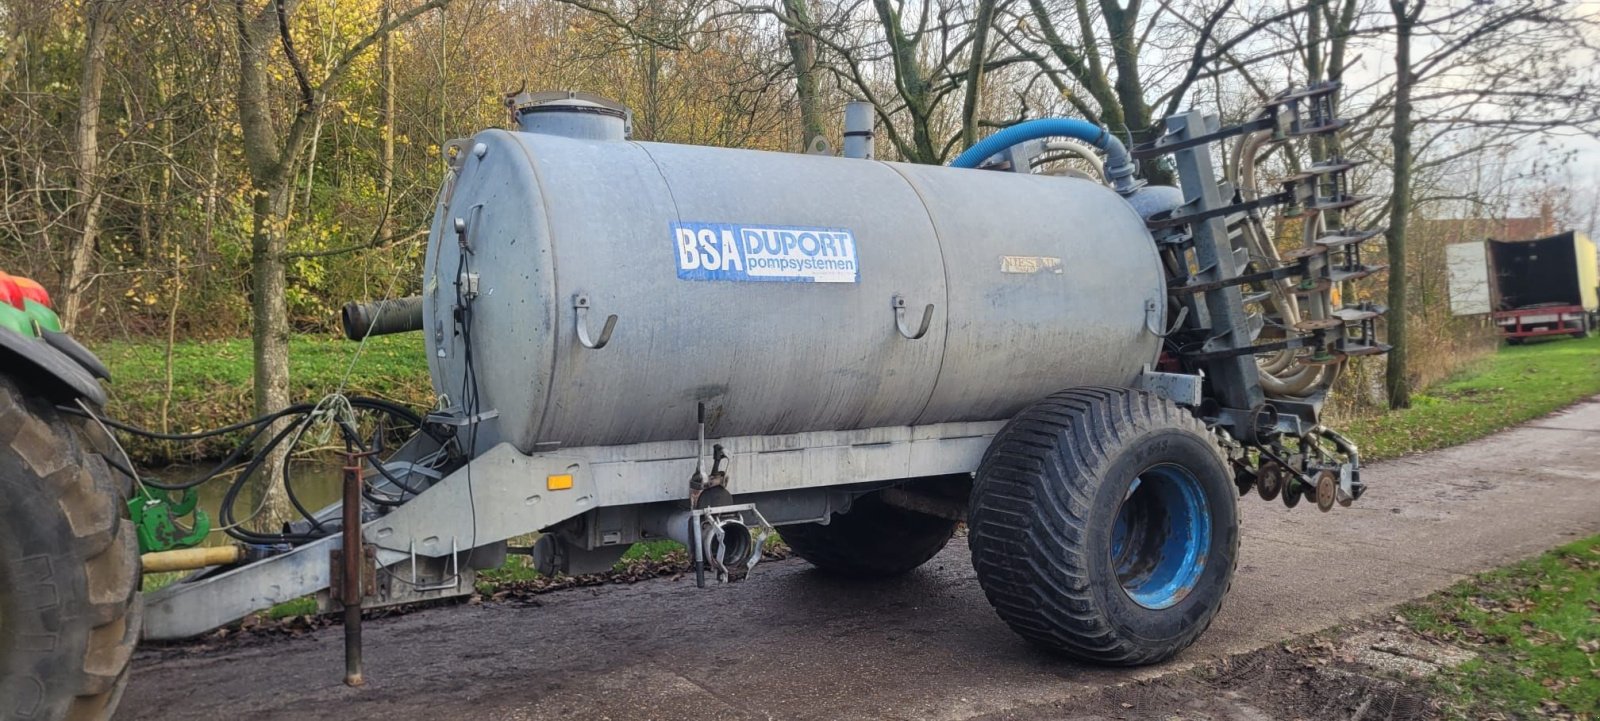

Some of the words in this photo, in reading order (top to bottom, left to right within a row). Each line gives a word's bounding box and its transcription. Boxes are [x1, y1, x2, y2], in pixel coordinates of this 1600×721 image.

[676, 228, 743, 271] BSA
[743, 231, 848, 257] DUPORT
[748, 256, 853, 271] pompsystemen
